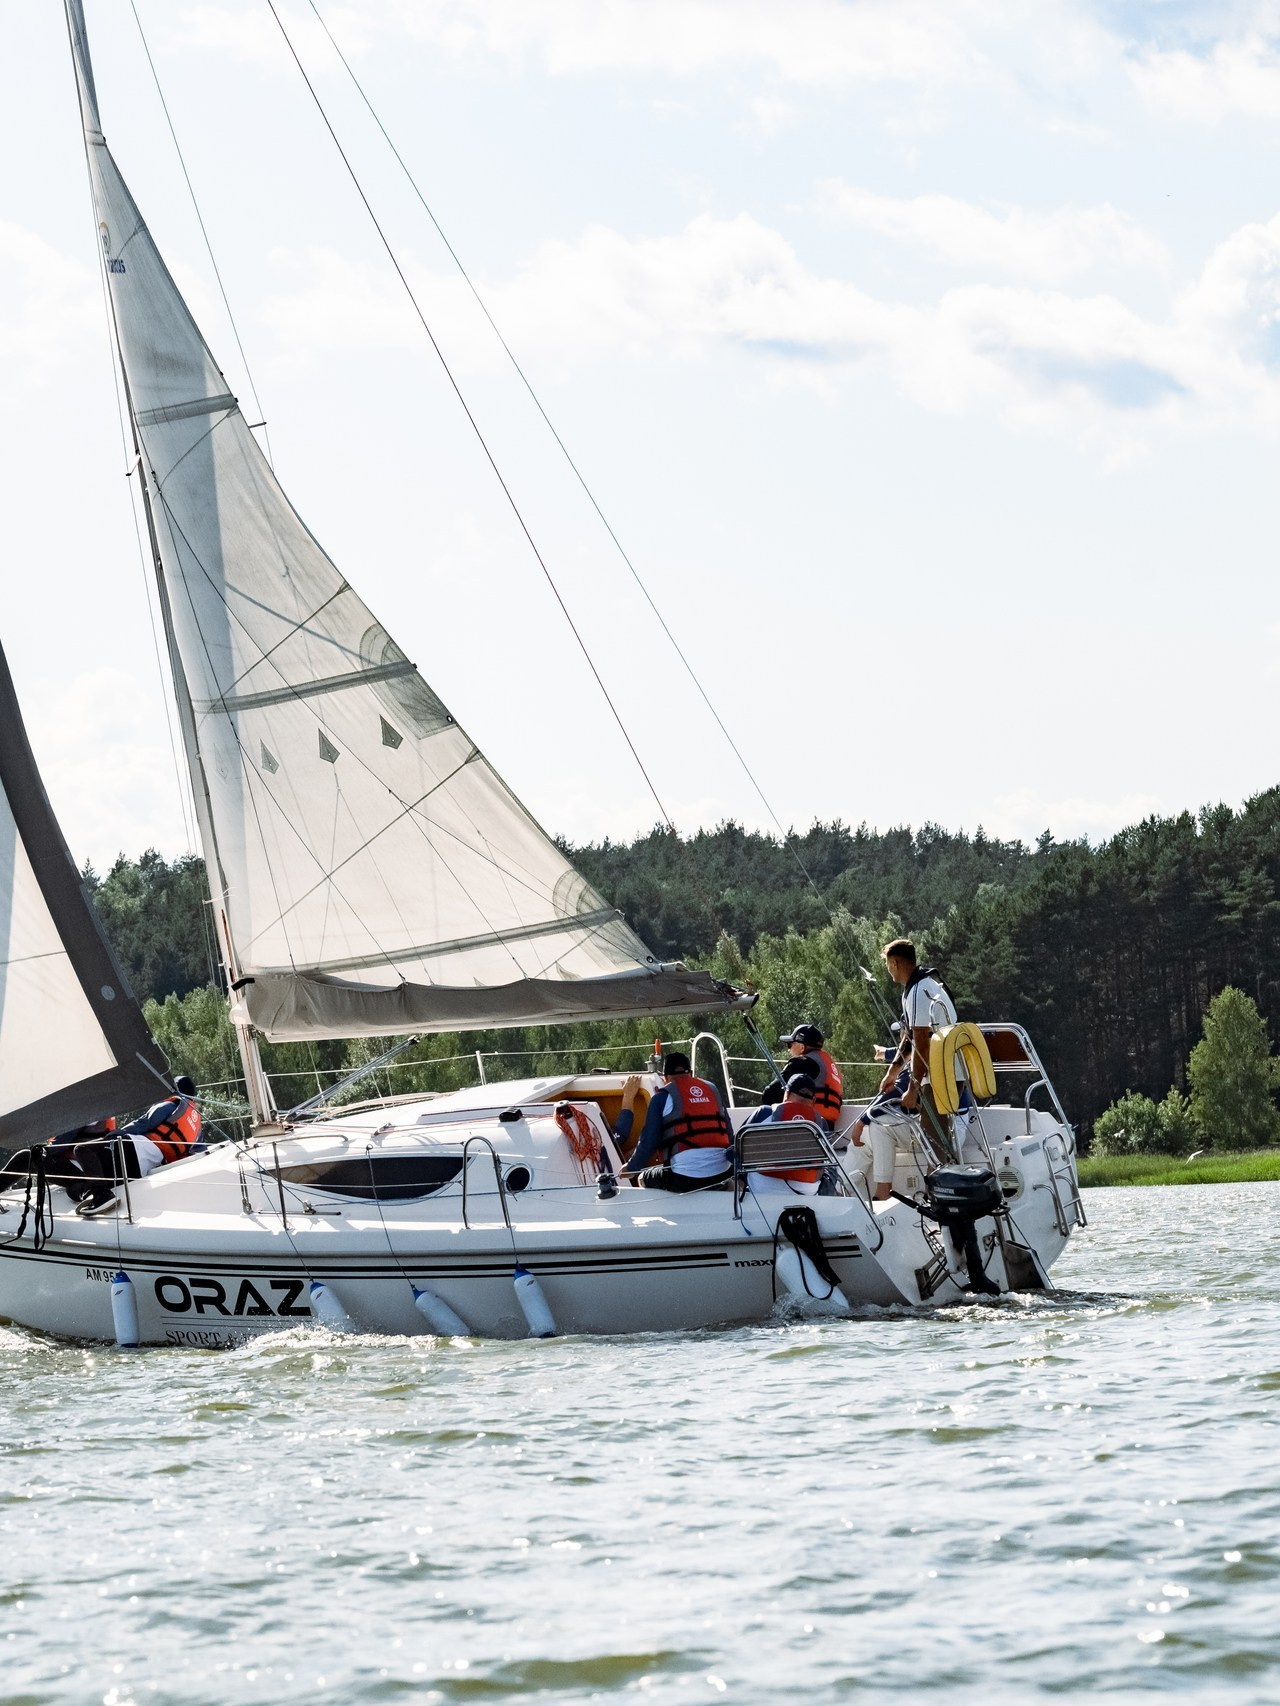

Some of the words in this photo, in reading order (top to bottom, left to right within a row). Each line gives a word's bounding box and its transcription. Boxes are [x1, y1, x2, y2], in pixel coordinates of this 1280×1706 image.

[86, 1268, 102, 1282] AM
[154, 1275, 312, 1317] ORAZ
[165, 1330, 222, 1345] SPORT
